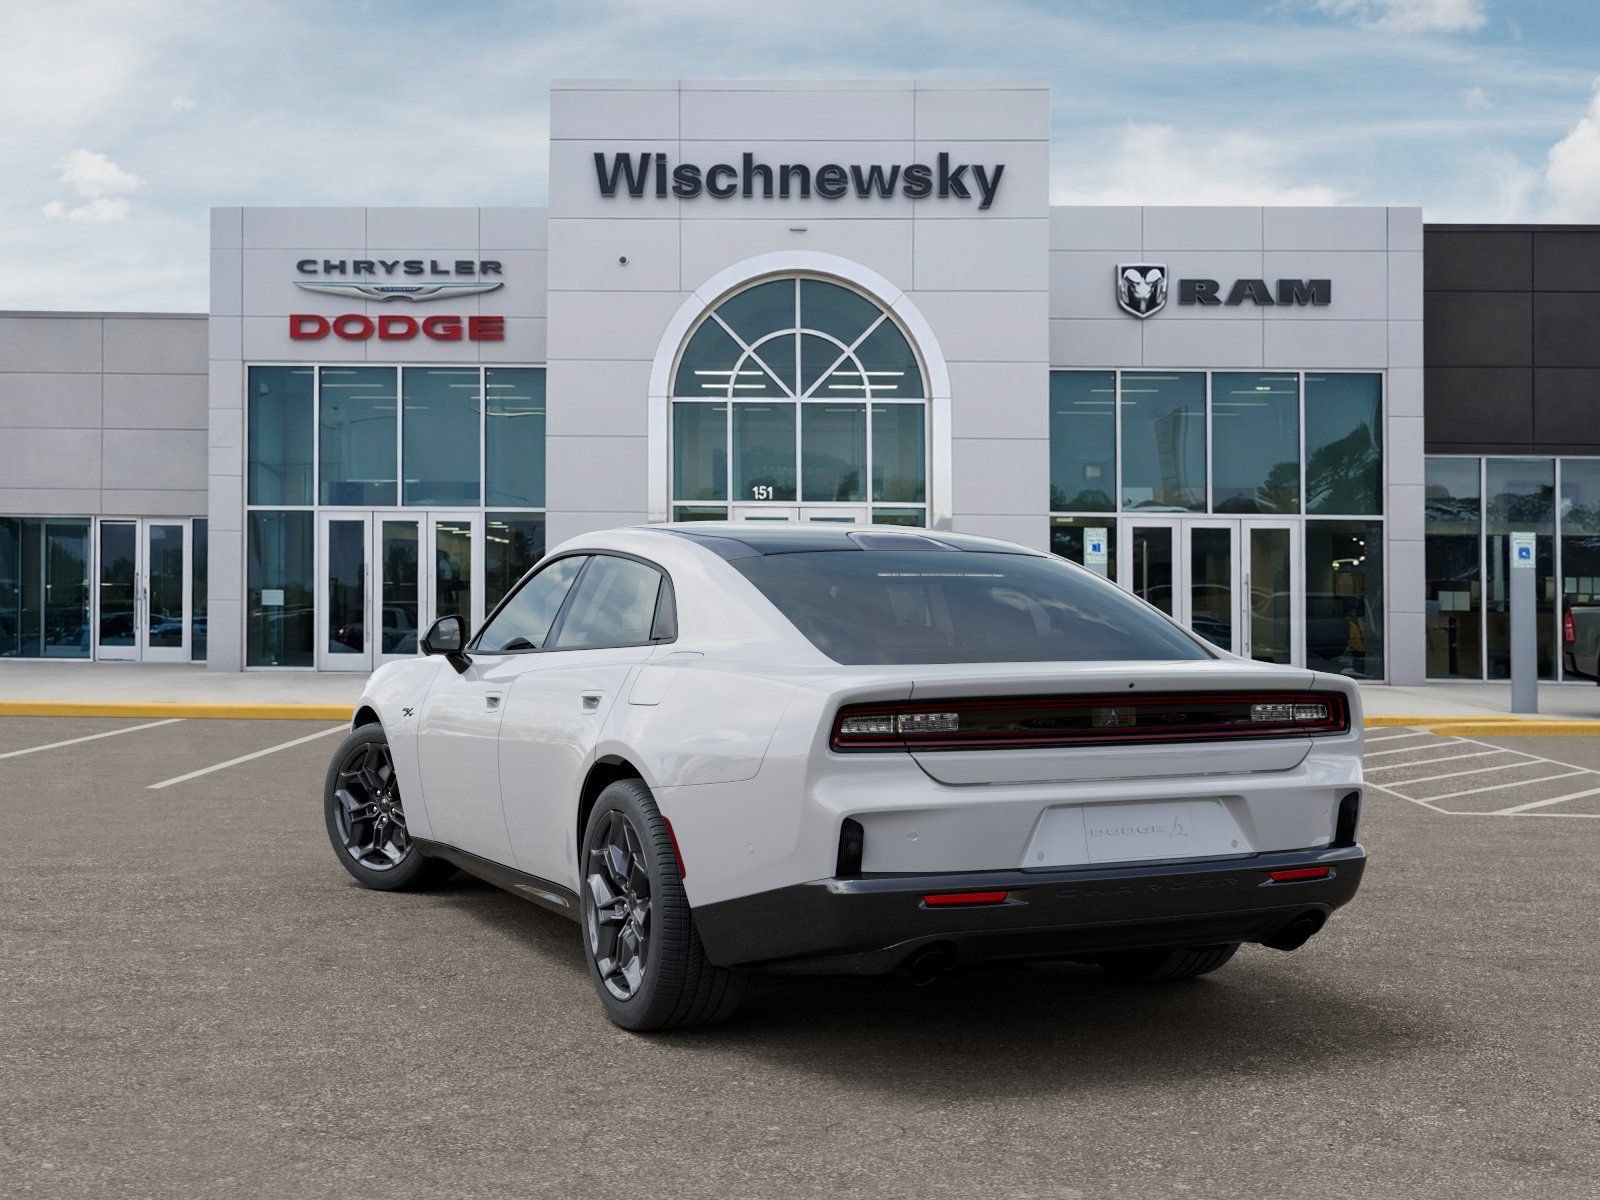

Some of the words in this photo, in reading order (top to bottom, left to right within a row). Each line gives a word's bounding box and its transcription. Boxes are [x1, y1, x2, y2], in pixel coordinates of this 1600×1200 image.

[593, 152, 1006, 210] Wischnewsky
[296, 259, 503, 275] CHRYSLER
[1177, 278, 1332, 306] RAM
[289, 314, 505, 341] DODGE
[752, 485, 773, 500] 151
